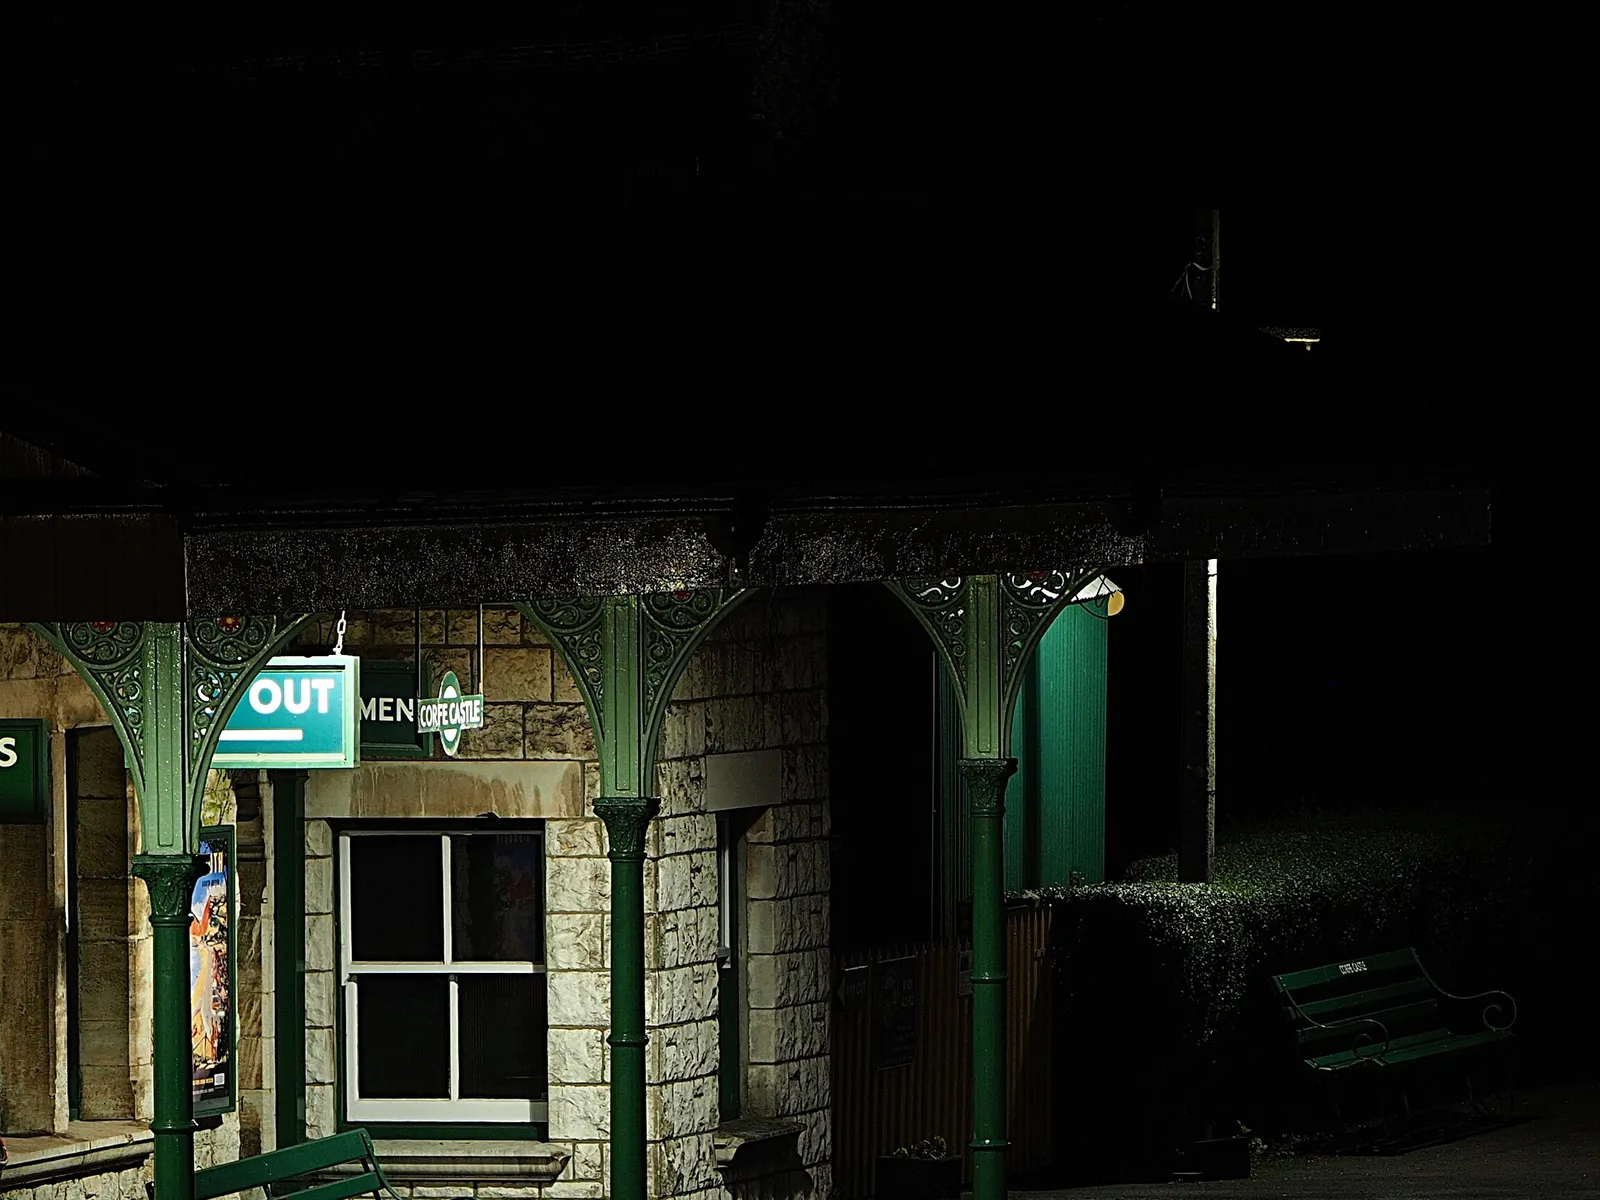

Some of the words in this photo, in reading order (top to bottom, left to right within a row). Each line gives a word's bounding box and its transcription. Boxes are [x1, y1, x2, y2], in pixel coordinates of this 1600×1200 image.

[249, 679, 335, 714] OUT
[359, 697, 414, 722] MEN
[420, 704, 449, 729] CORFE
[449, 699, 481, 725] CASTLE
